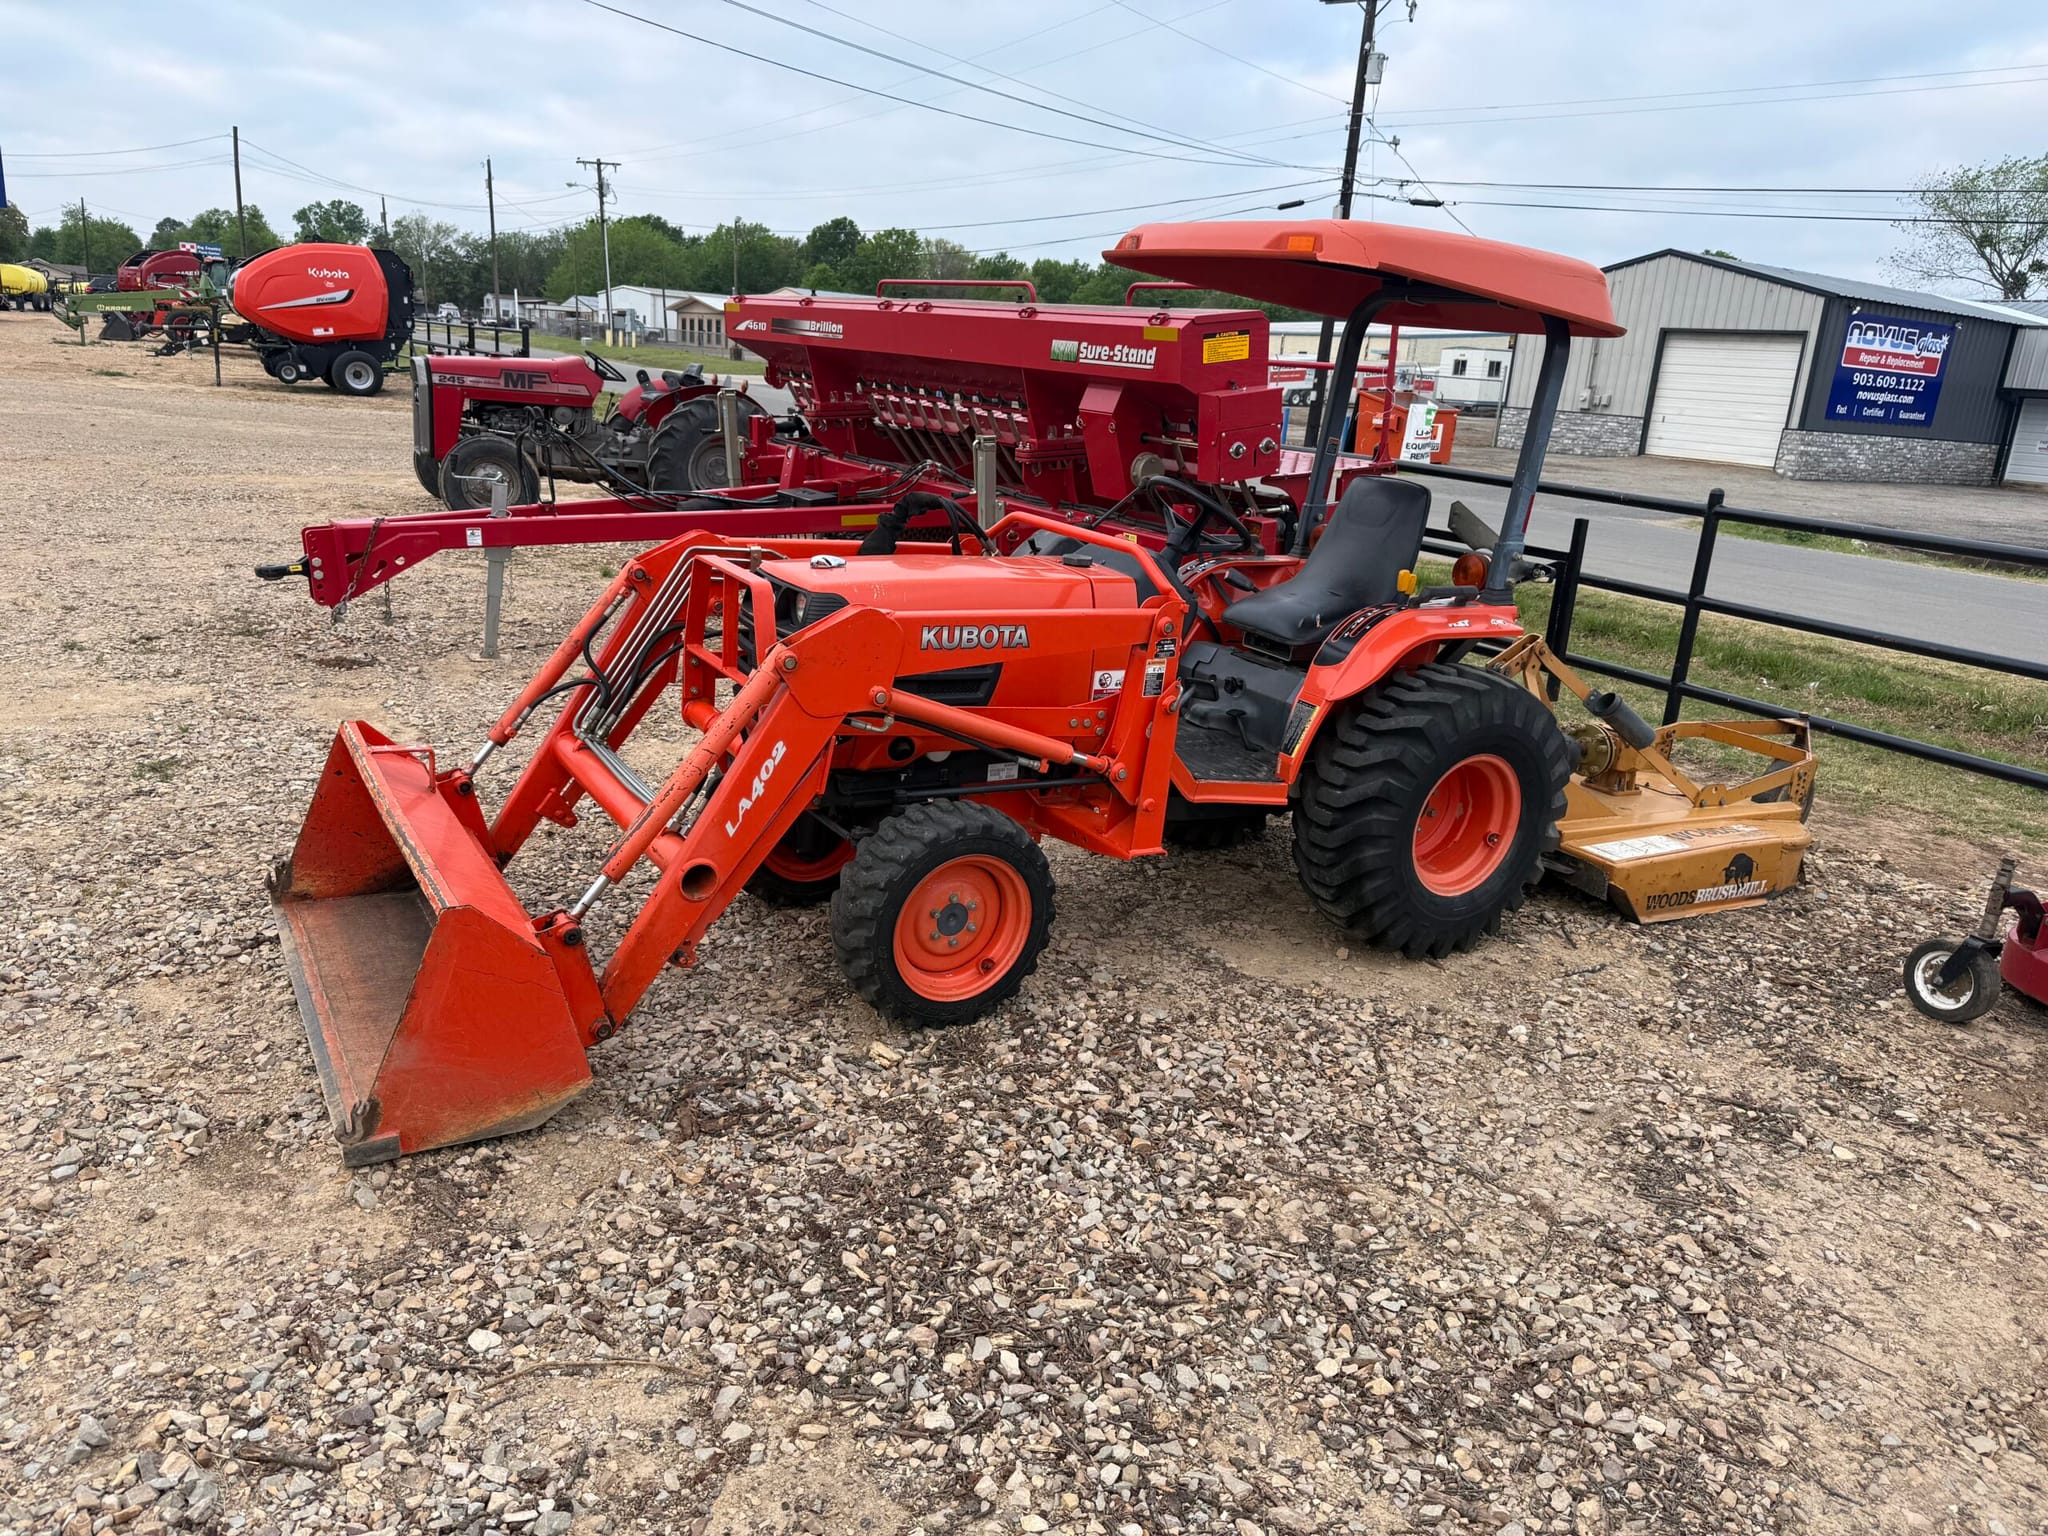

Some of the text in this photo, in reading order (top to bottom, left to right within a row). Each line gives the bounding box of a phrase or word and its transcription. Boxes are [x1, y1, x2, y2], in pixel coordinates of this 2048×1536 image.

[307, 267, 350, 279] Kubota
[748, 320, 843, 334] 4610 Brillion
[1916, 331, 1945, 358] glass
[1858, 352, 1925, 369] Repair & Replacement
[438, 371, 547, 390] 245 MF
[1852, 372, 1925, 392] 903.609.1122
[1856, 390, 1915, 405] novusglass.com
[1836, 404, 1926, 421] Fast Certified Guaranteed
[920, 623, 1030, 650] KUBOTA
[725, 740, 787, 838] LA402
